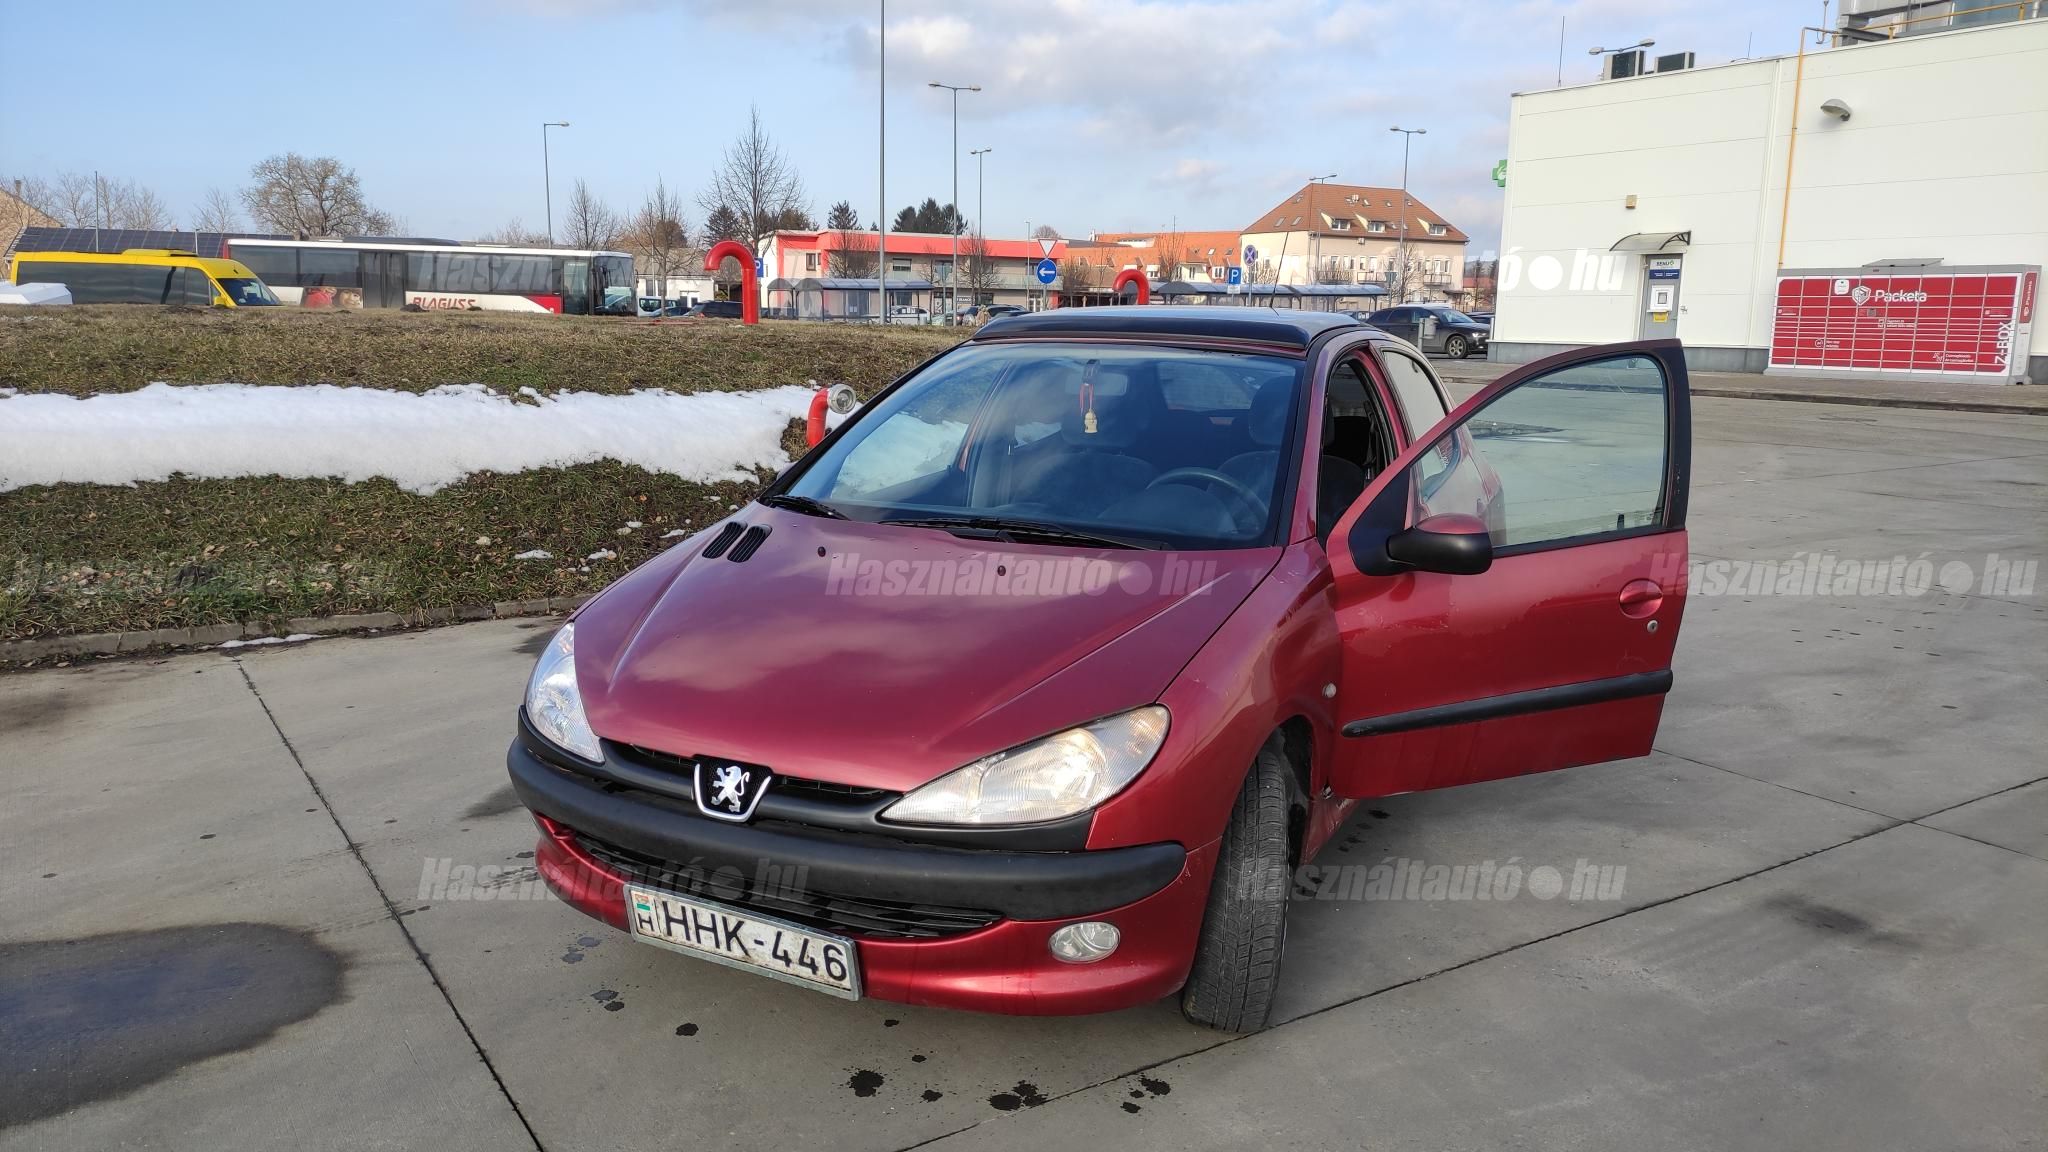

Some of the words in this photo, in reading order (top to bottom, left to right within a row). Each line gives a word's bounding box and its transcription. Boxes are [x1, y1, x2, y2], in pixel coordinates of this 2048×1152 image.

[1230, 269, 1240, 282] P
[1875, 289, 1927, 302] Packeta
[1994, 321, 2012, 364] Z-BOX
[638, 912, 654, 931] H
[662, 901, 847, 981] HHK-446
